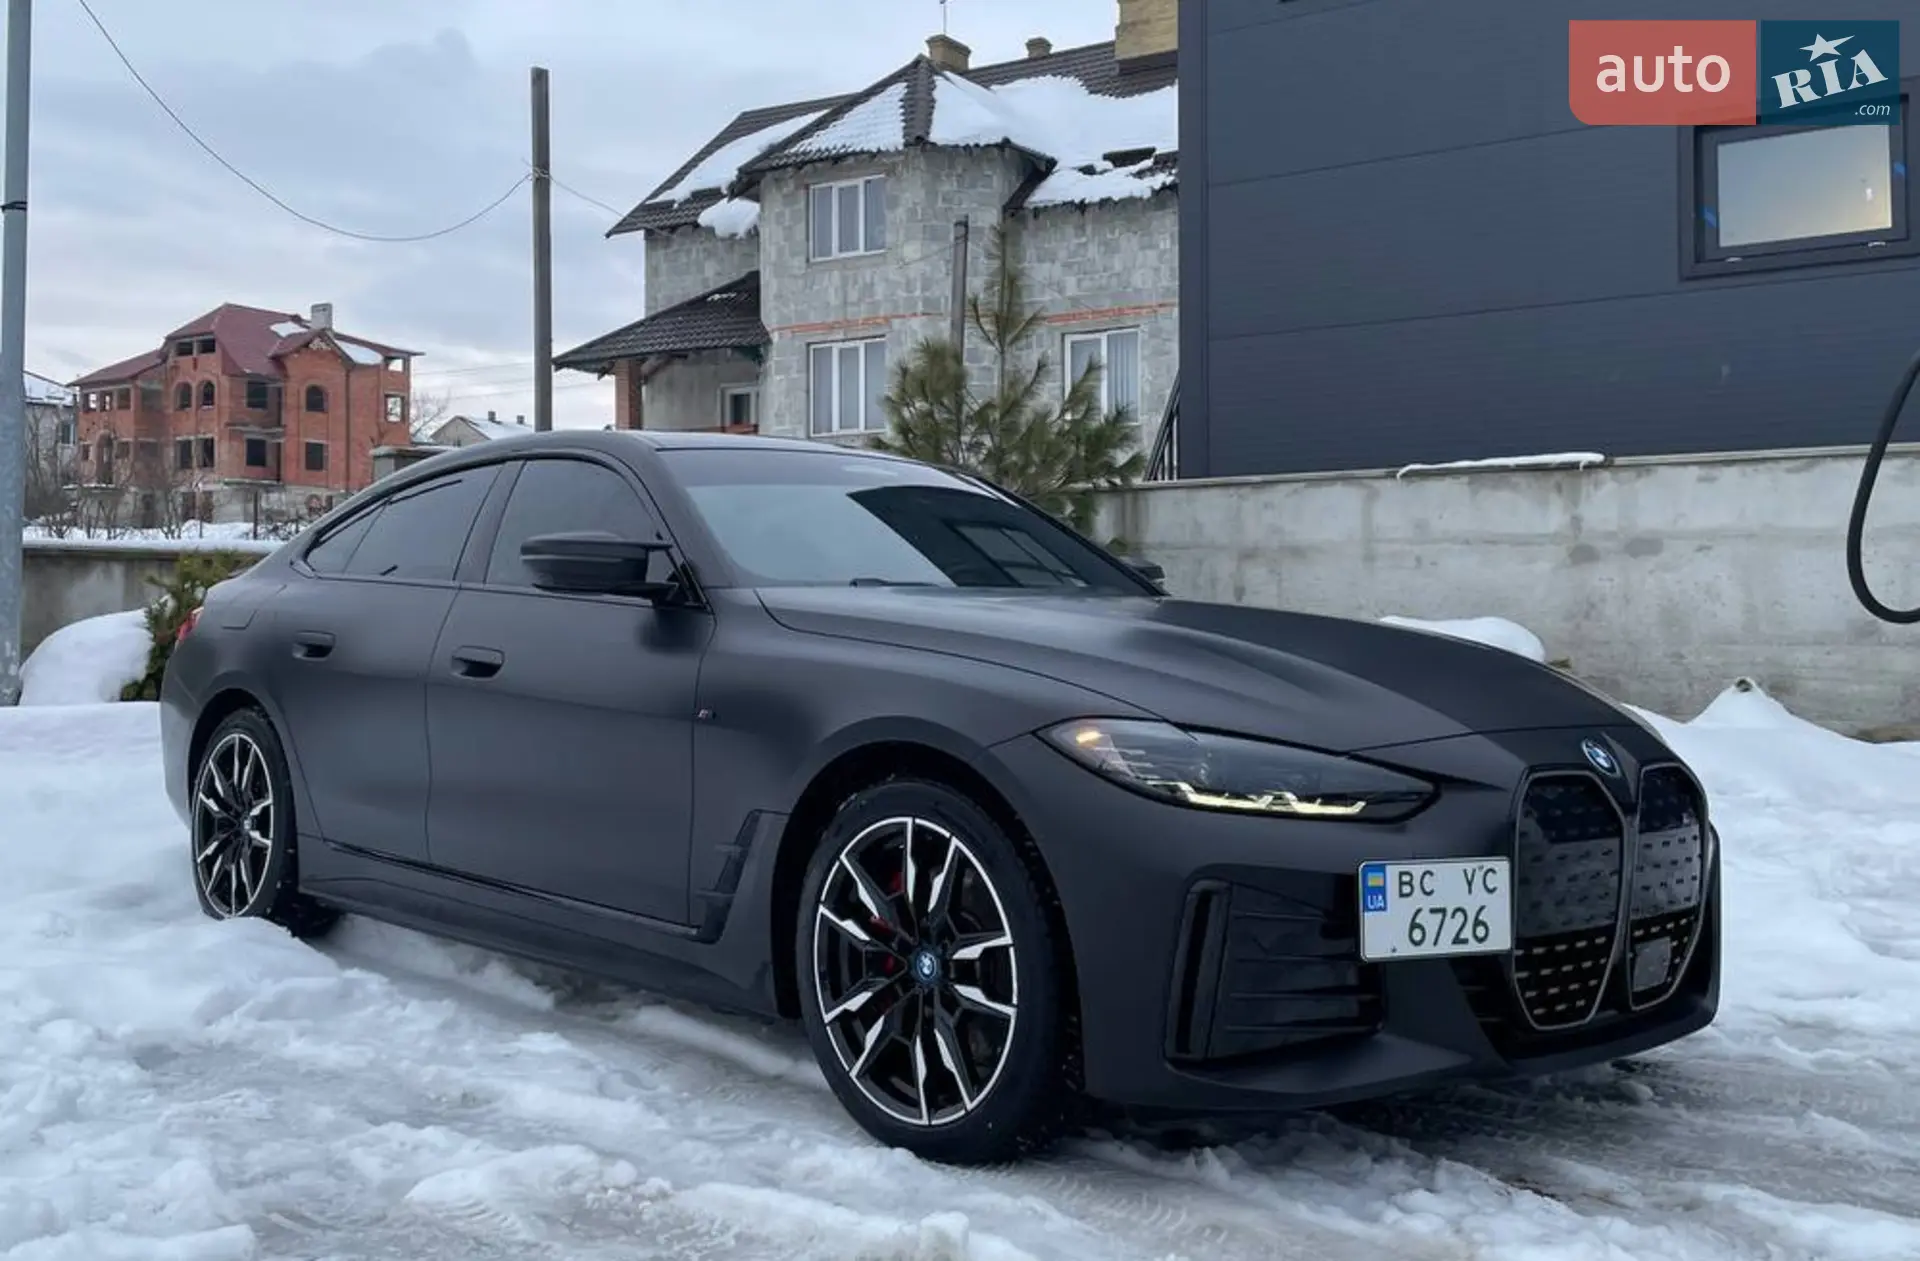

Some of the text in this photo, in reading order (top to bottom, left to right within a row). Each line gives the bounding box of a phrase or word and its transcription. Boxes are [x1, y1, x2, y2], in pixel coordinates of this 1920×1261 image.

[1399, 868, 1498, 897] BC YC
[1367, 895, 1385, 909] UA
[1408, 905, 1490, 947] 6726
